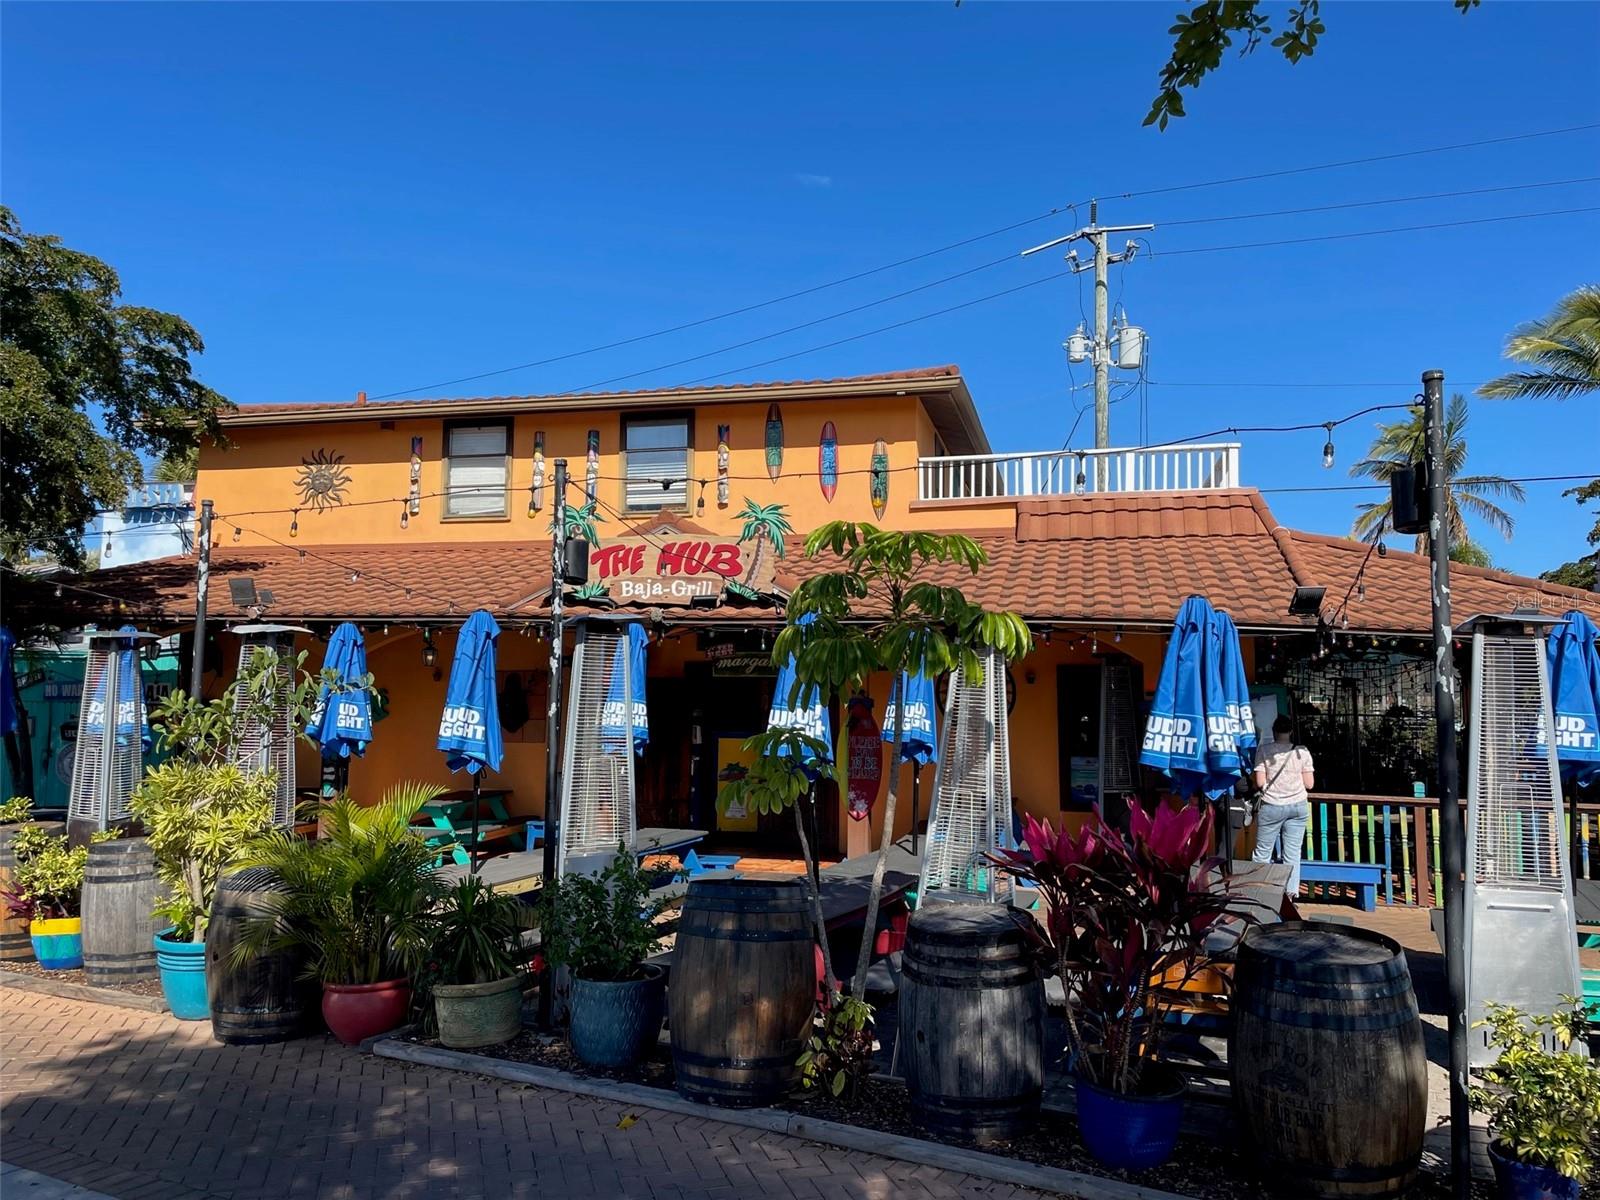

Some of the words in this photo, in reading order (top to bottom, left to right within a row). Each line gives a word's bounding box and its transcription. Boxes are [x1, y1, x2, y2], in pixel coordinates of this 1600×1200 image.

[590, 544, 647, 579] THE
[657, 541, 744, 577] HUB
[620, 580, 713, 599] Baja-Grill
[717, 657, 770, 674] marga
[339, 703, 359, 717] UD
